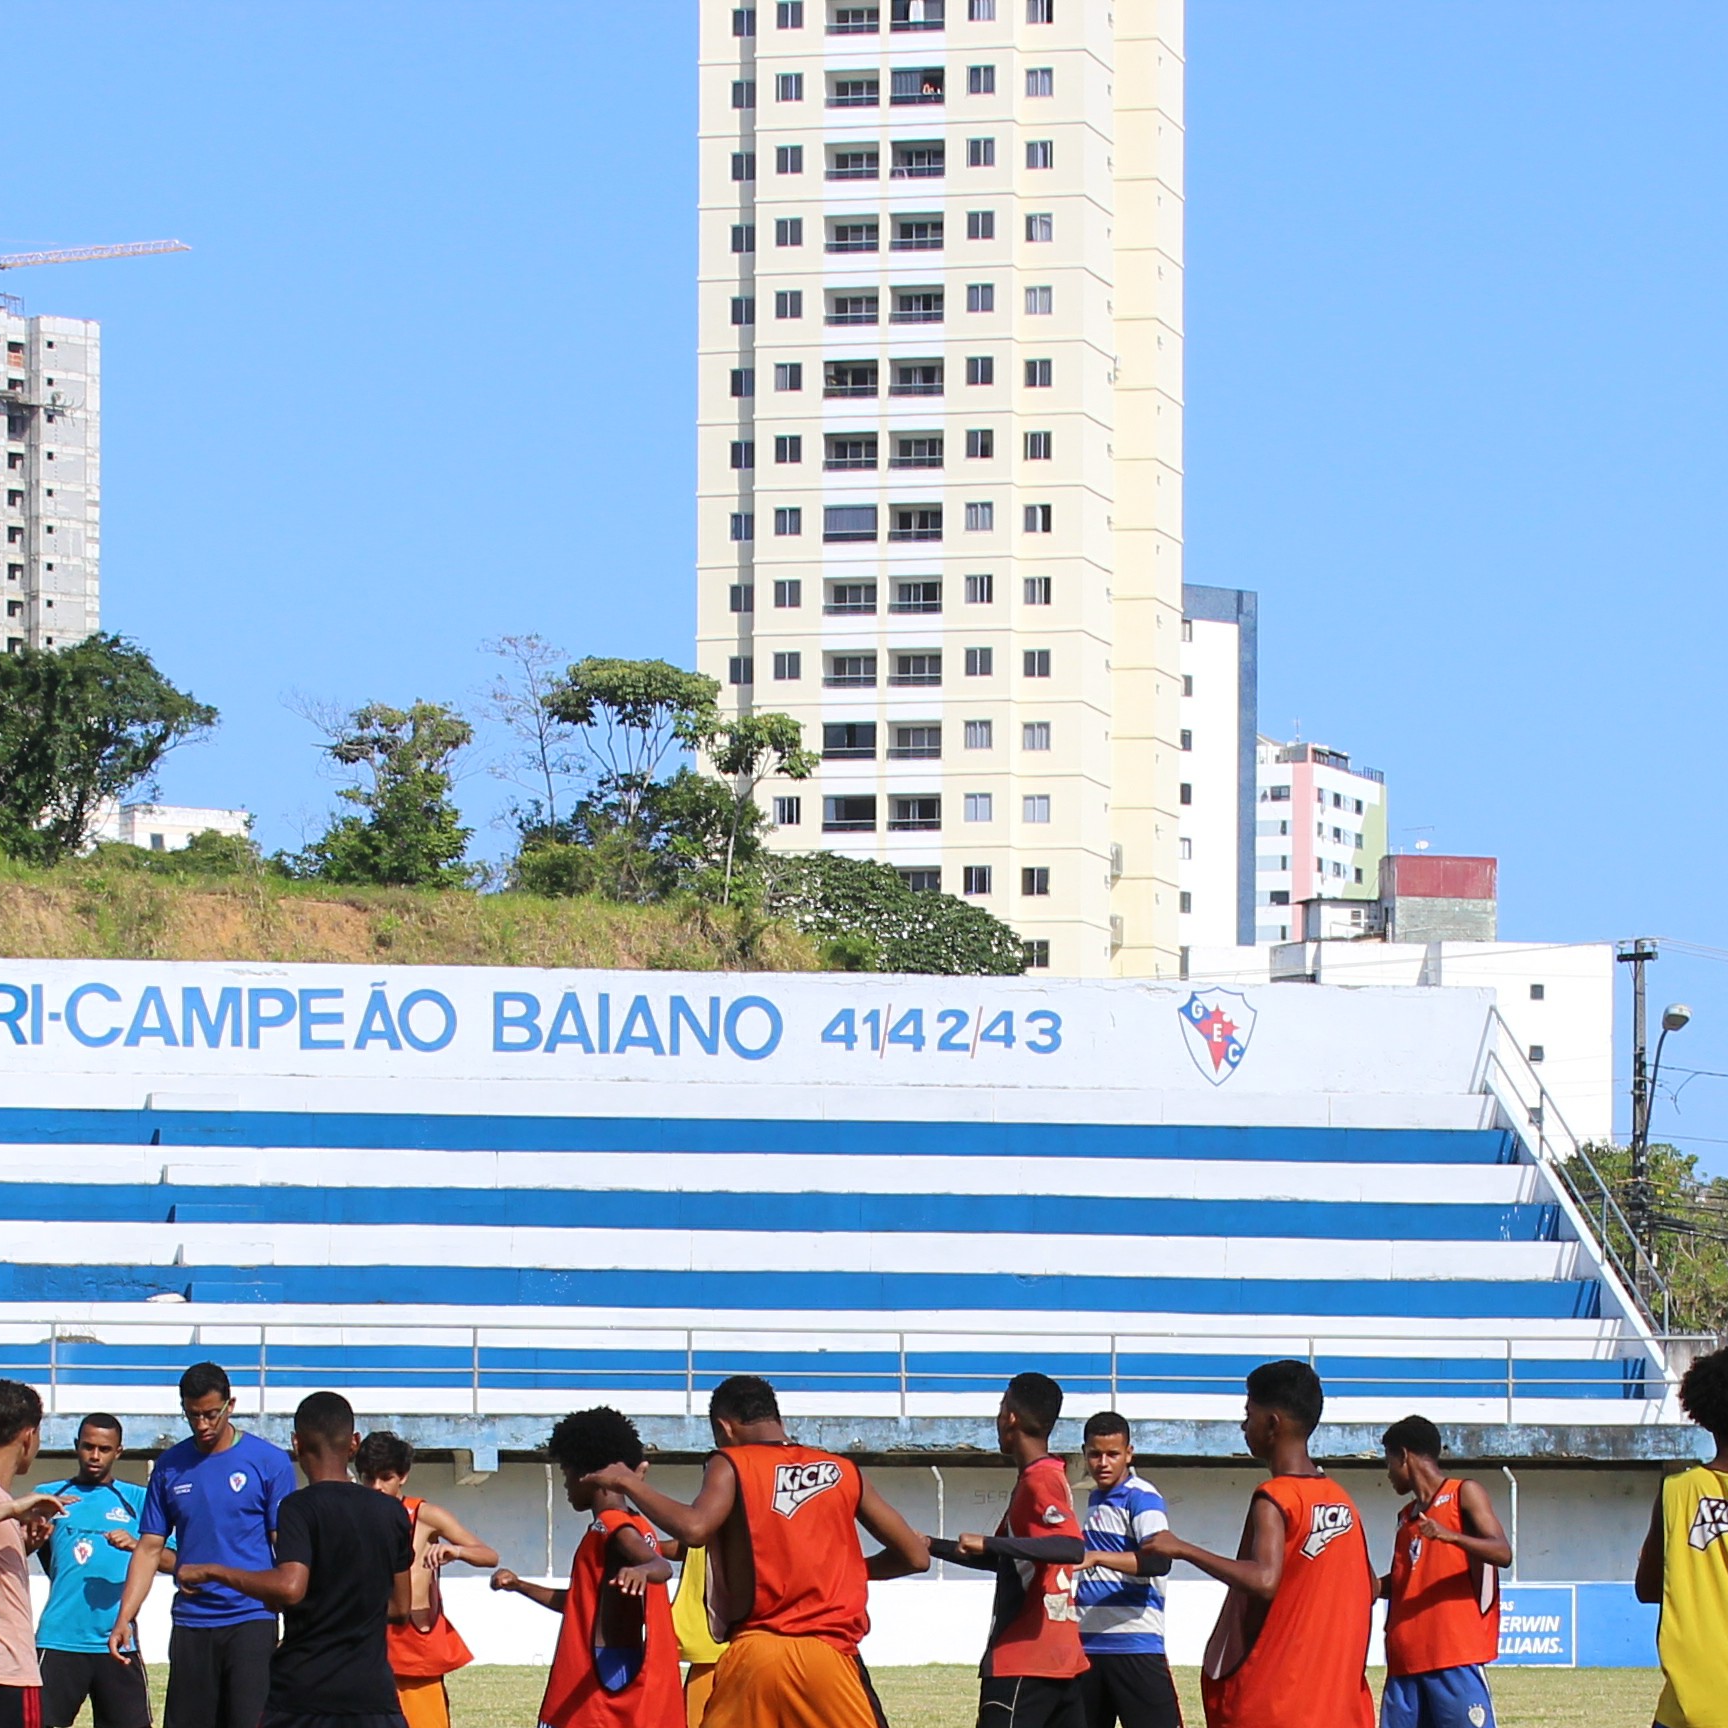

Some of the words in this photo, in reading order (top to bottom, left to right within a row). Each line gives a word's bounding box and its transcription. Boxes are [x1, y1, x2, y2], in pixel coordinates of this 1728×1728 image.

[492, 990, 784, 1061] BAIANO
[1499, 1616, 1560, 1633] ERWIN
[1498, 1637, 1564, 1654] LLIAMS.
